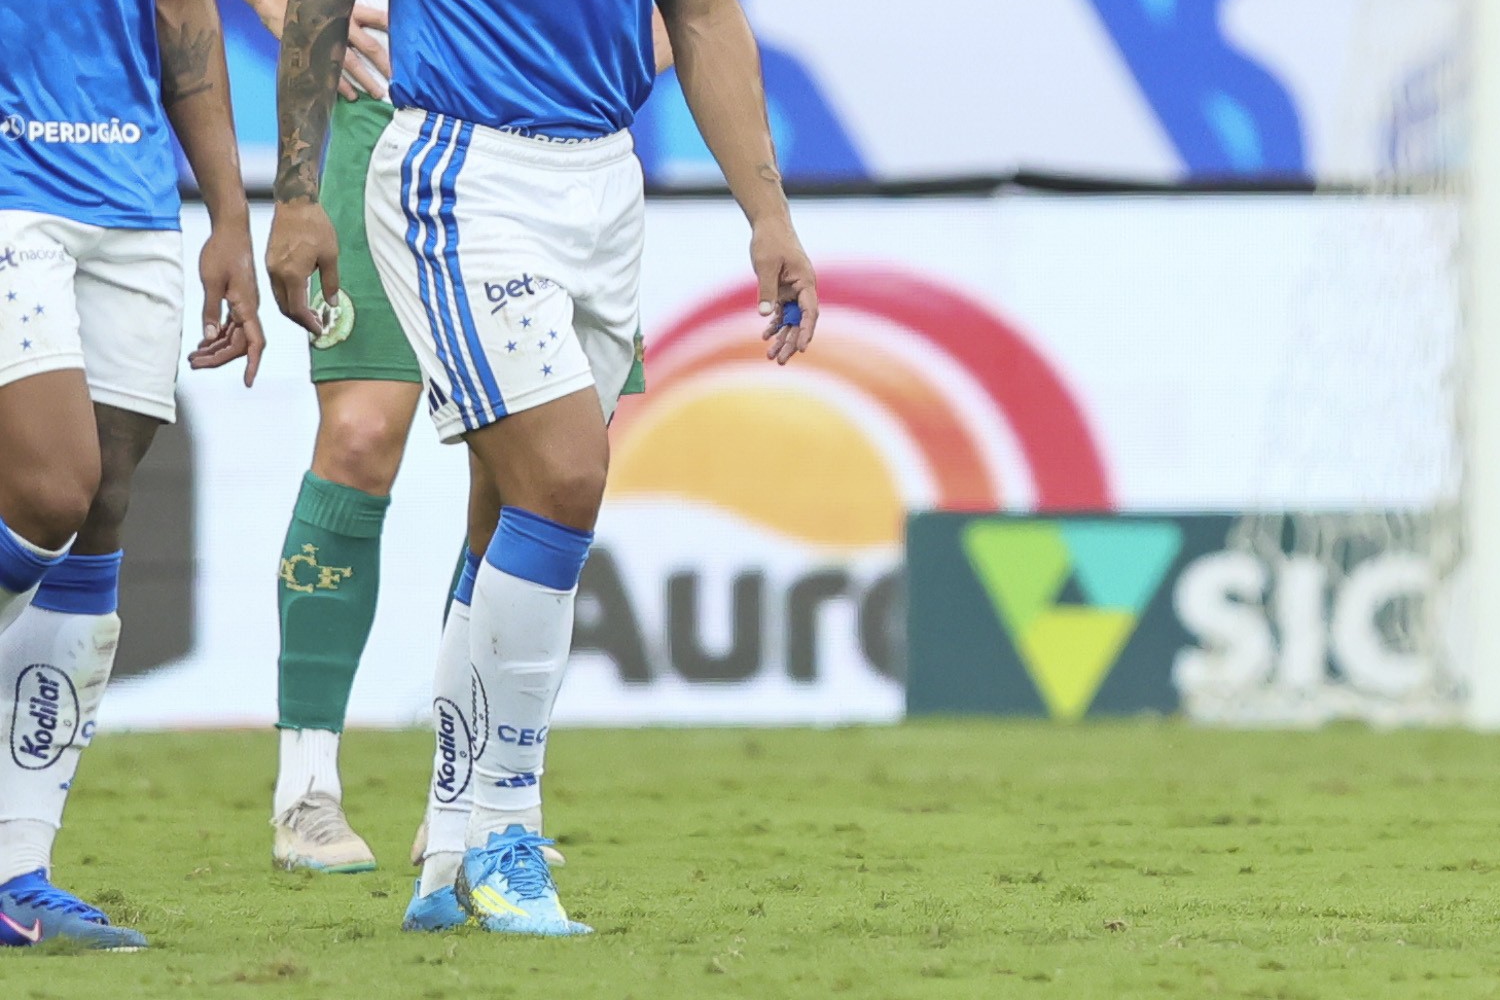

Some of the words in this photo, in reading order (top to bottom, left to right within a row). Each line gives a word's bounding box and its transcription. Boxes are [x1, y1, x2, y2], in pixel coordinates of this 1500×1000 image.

[28, 117, 141, 144] PERDIGÃO
[20, 671, 60, 760] Kodilar
[436, 705, 456, 793] Kodilar
